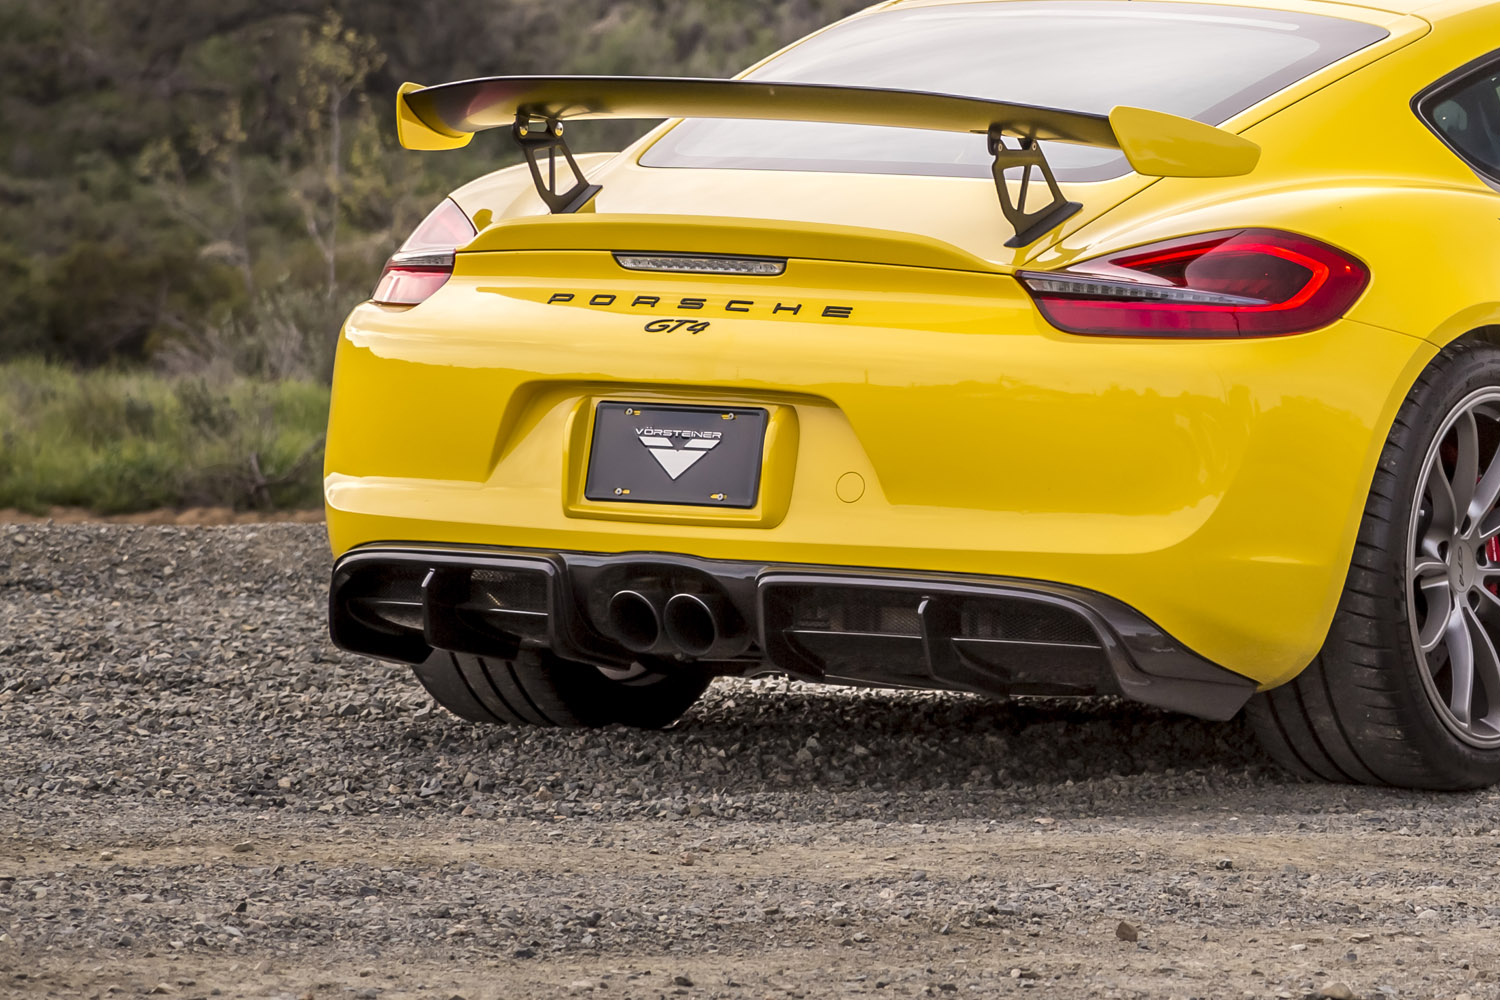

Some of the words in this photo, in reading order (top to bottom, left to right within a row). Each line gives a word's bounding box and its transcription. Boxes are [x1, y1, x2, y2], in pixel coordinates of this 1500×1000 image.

[547, 293, 853, 318] PORSCHE
[644, 319, 710, 334] GT4
[635, 426, 722, 438] VÖRSTEINER
